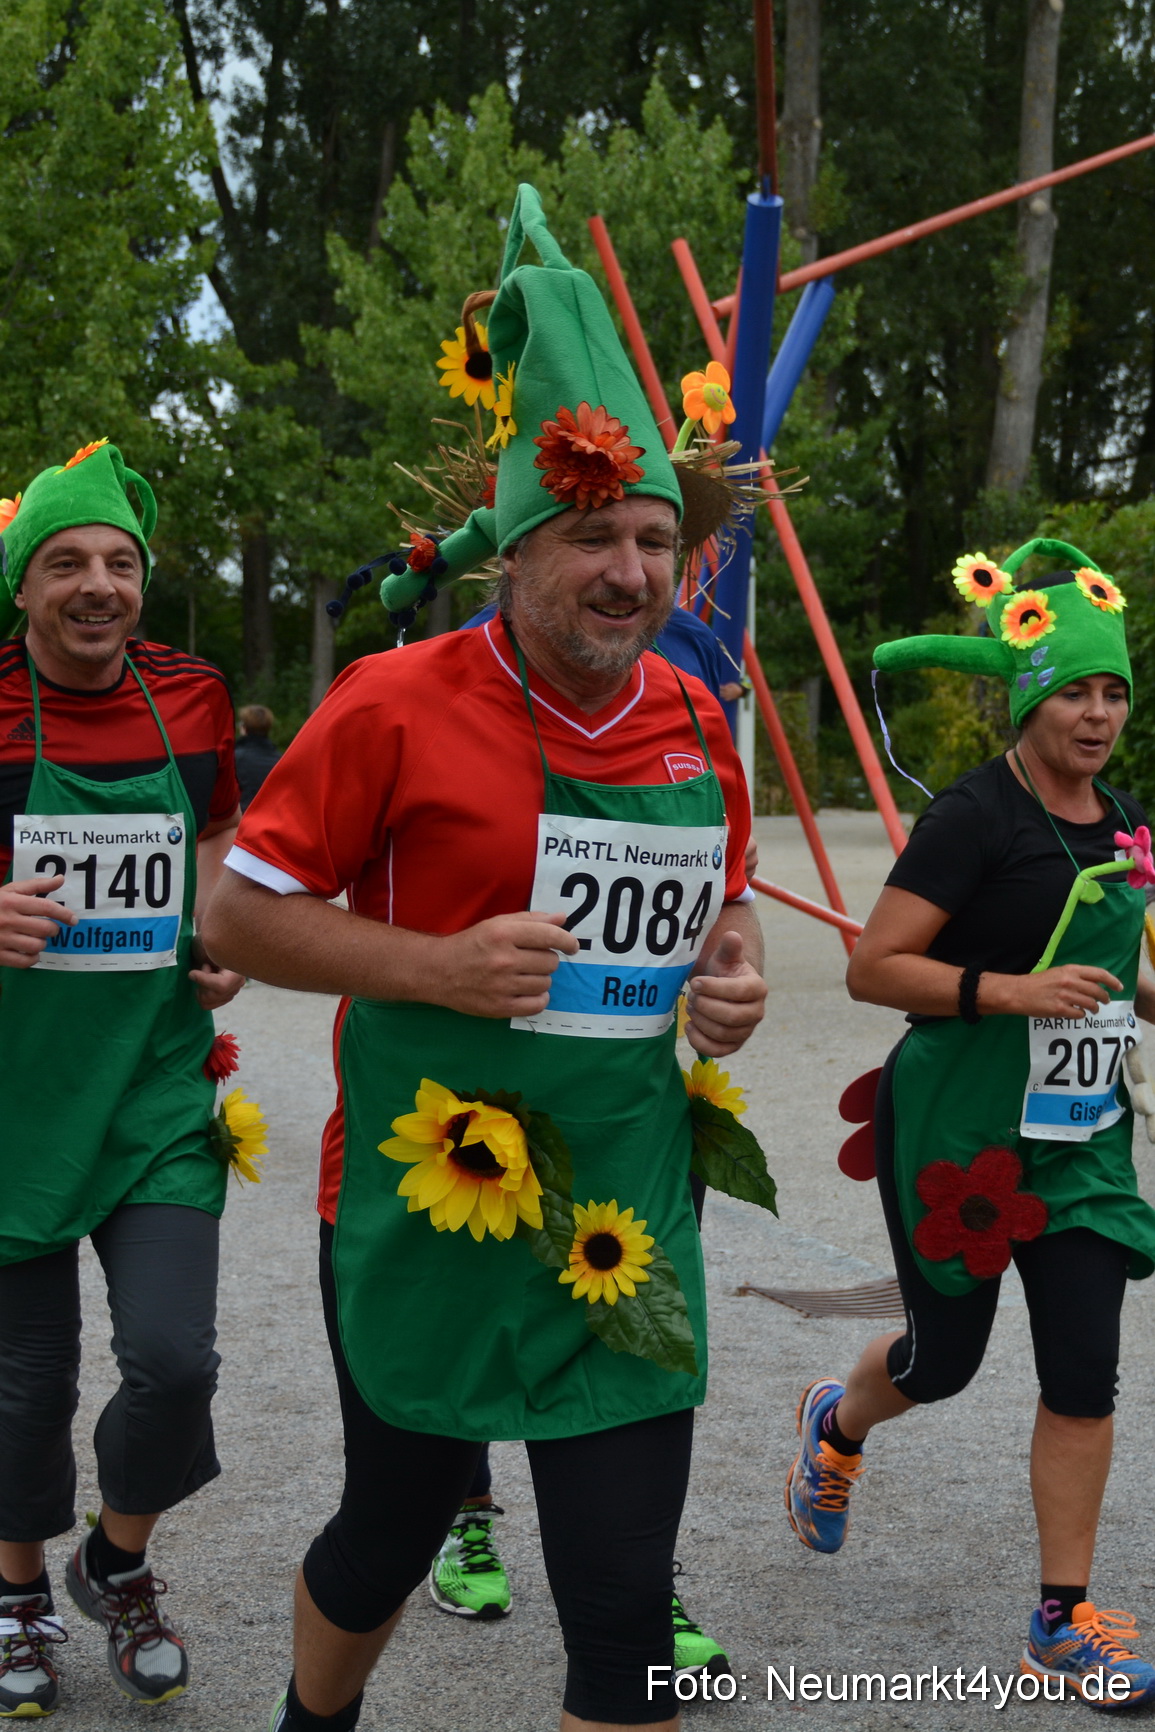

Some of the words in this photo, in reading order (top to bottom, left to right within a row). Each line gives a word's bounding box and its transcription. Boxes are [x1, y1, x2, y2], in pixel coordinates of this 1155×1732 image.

[6, 732, 48, 741] adids
[20, 830, 78, 845] PARTL
[83, 830, 161, 844] Neumarkt
[544, 836, 618, 862] PARTL
[624, 845, 709, 868] Neumarkt
[34, 852, 172, 910] 2140
[559, 872, 713, 956] 2084
[50, 926, 154, 953] Wolfgang
[601, 976, 659, 1008] Reto
[1033, 1017, 1081, 1031] PARTL
[1084, 1015, 1126, 1029] Neumarkt
[1069, 1101, 1108, 1121] Gise
